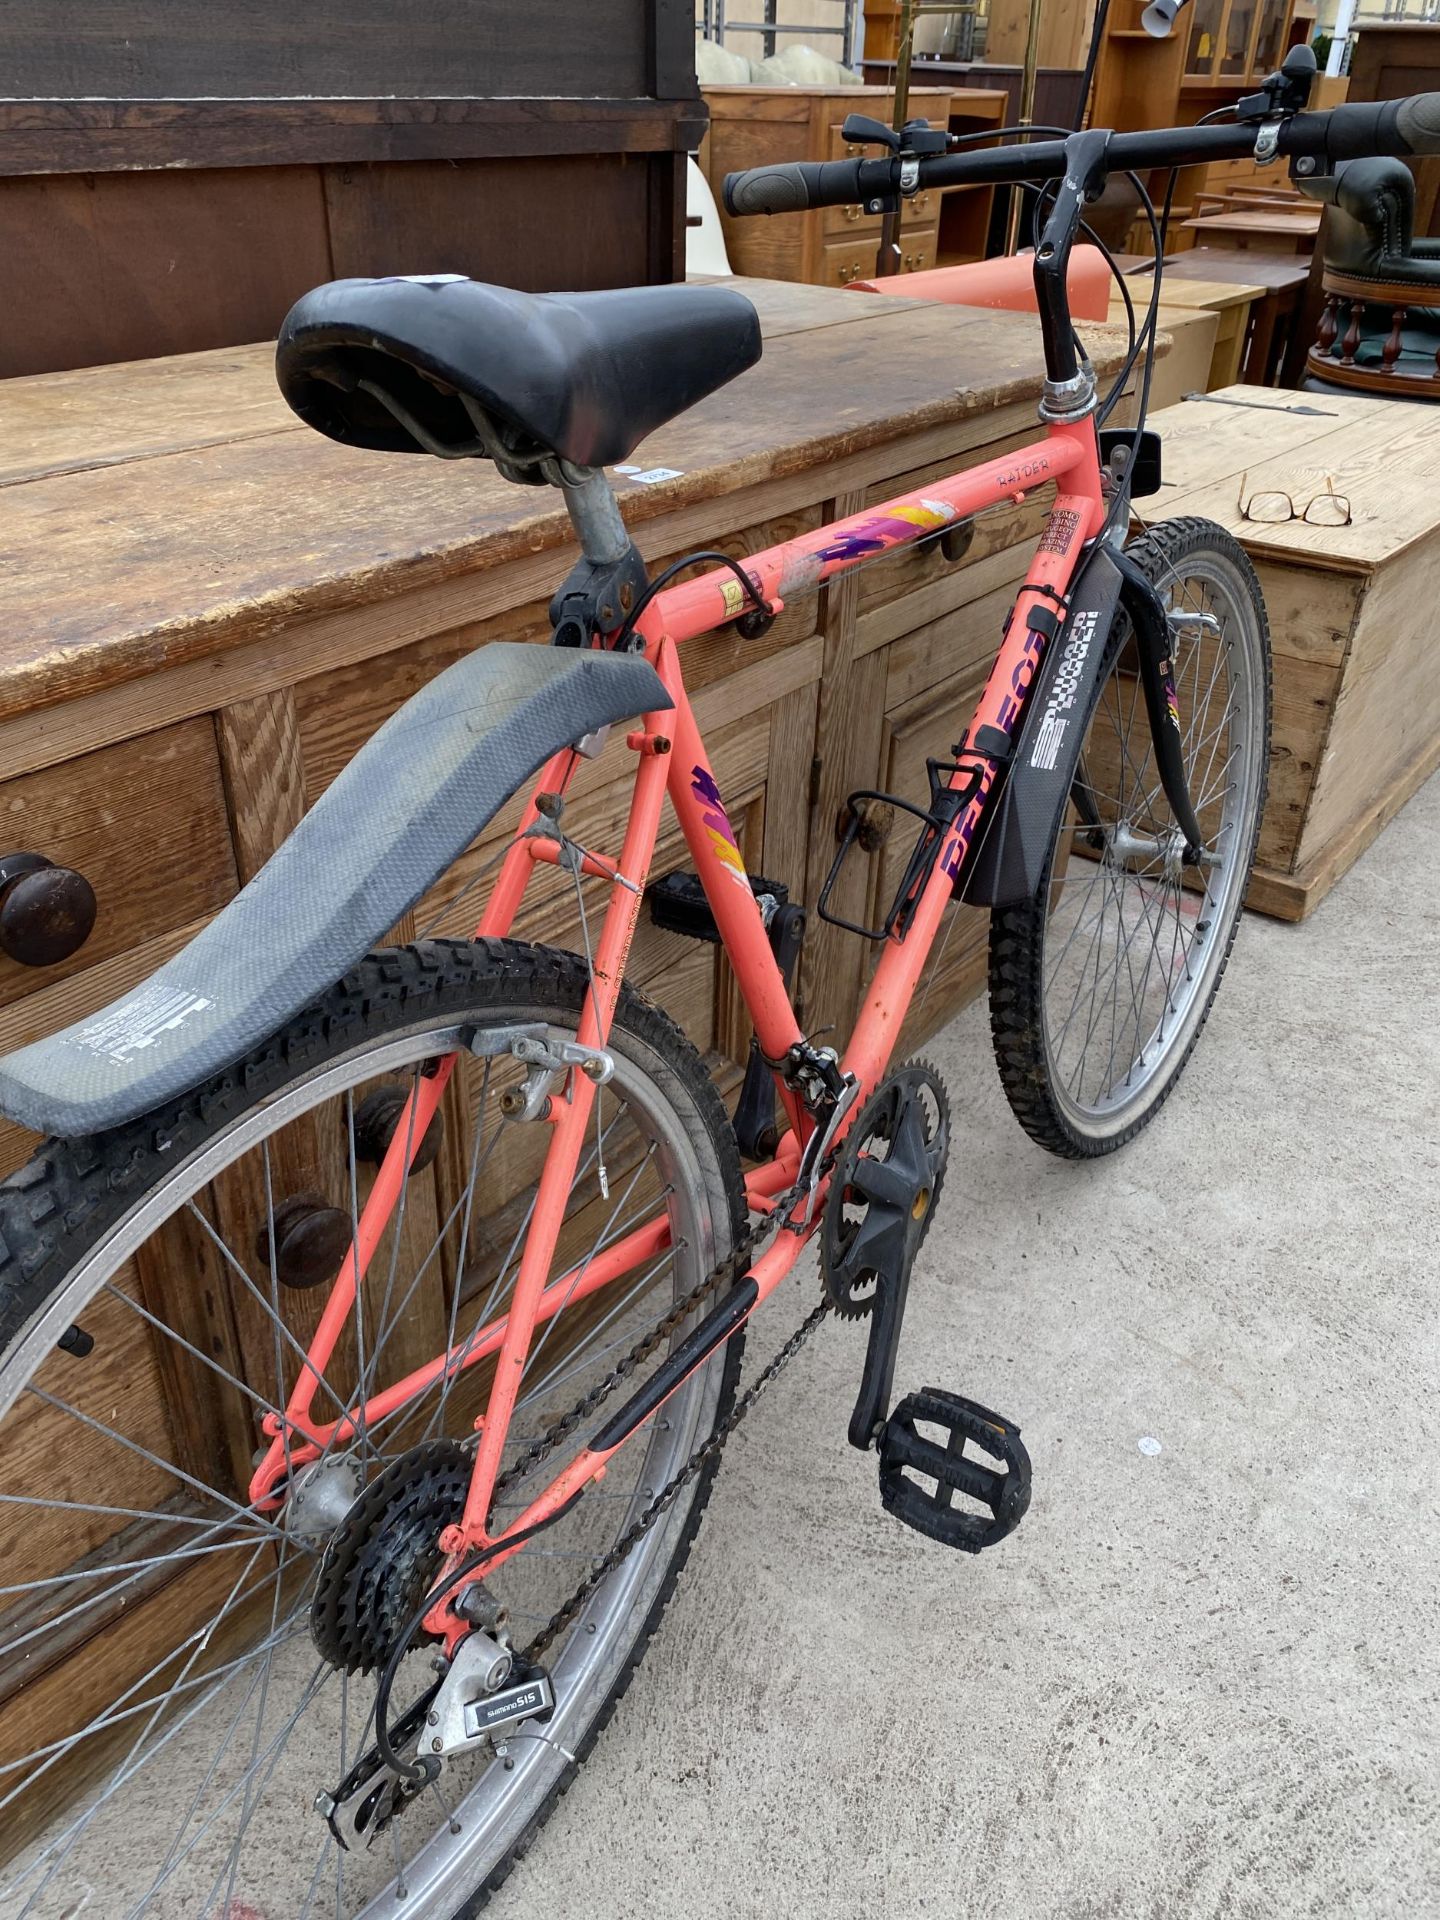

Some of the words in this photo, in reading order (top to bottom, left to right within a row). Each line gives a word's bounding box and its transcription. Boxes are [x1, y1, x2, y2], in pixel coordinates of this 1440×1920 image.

[996, 458, 1049, 487] RAIDER
[1030, 611, 1099, 770] PLUGGER
[940, 628, 1046, 882] PEUEOT
[487, 1702, 518, 1718] SHIMANO
[516, 1692, 536, 1707] SIS
